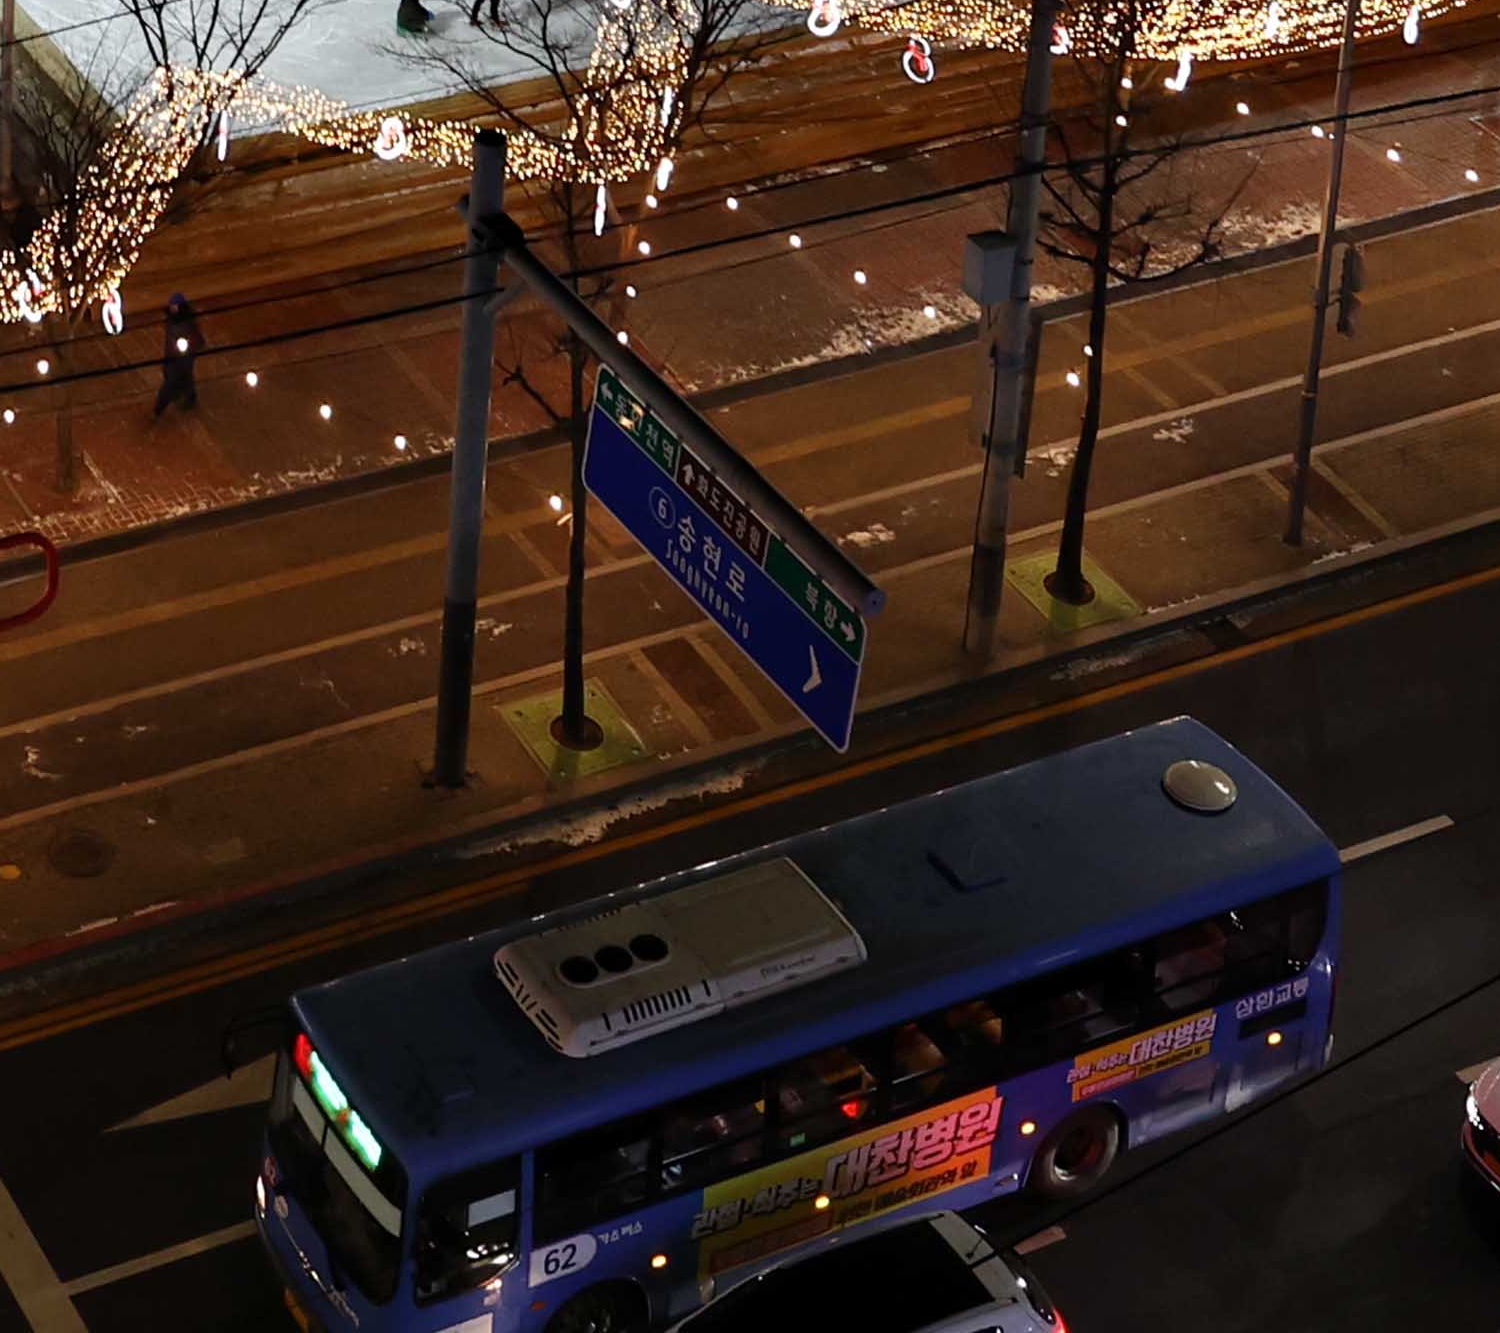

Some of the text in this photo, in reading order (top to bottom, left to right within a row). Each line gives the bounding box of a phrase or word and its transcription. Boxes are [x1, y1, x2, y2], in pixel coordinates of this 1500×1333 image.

[696, 475, 762, 557] 화도진공원
[677, 515, 746, 603] 송현로
[1129, 1013, 1219, 1066] 대찬병원
[823, 1096, 1005, 1199] 대찬병원
[543, 1242, 578, 1276] 62
